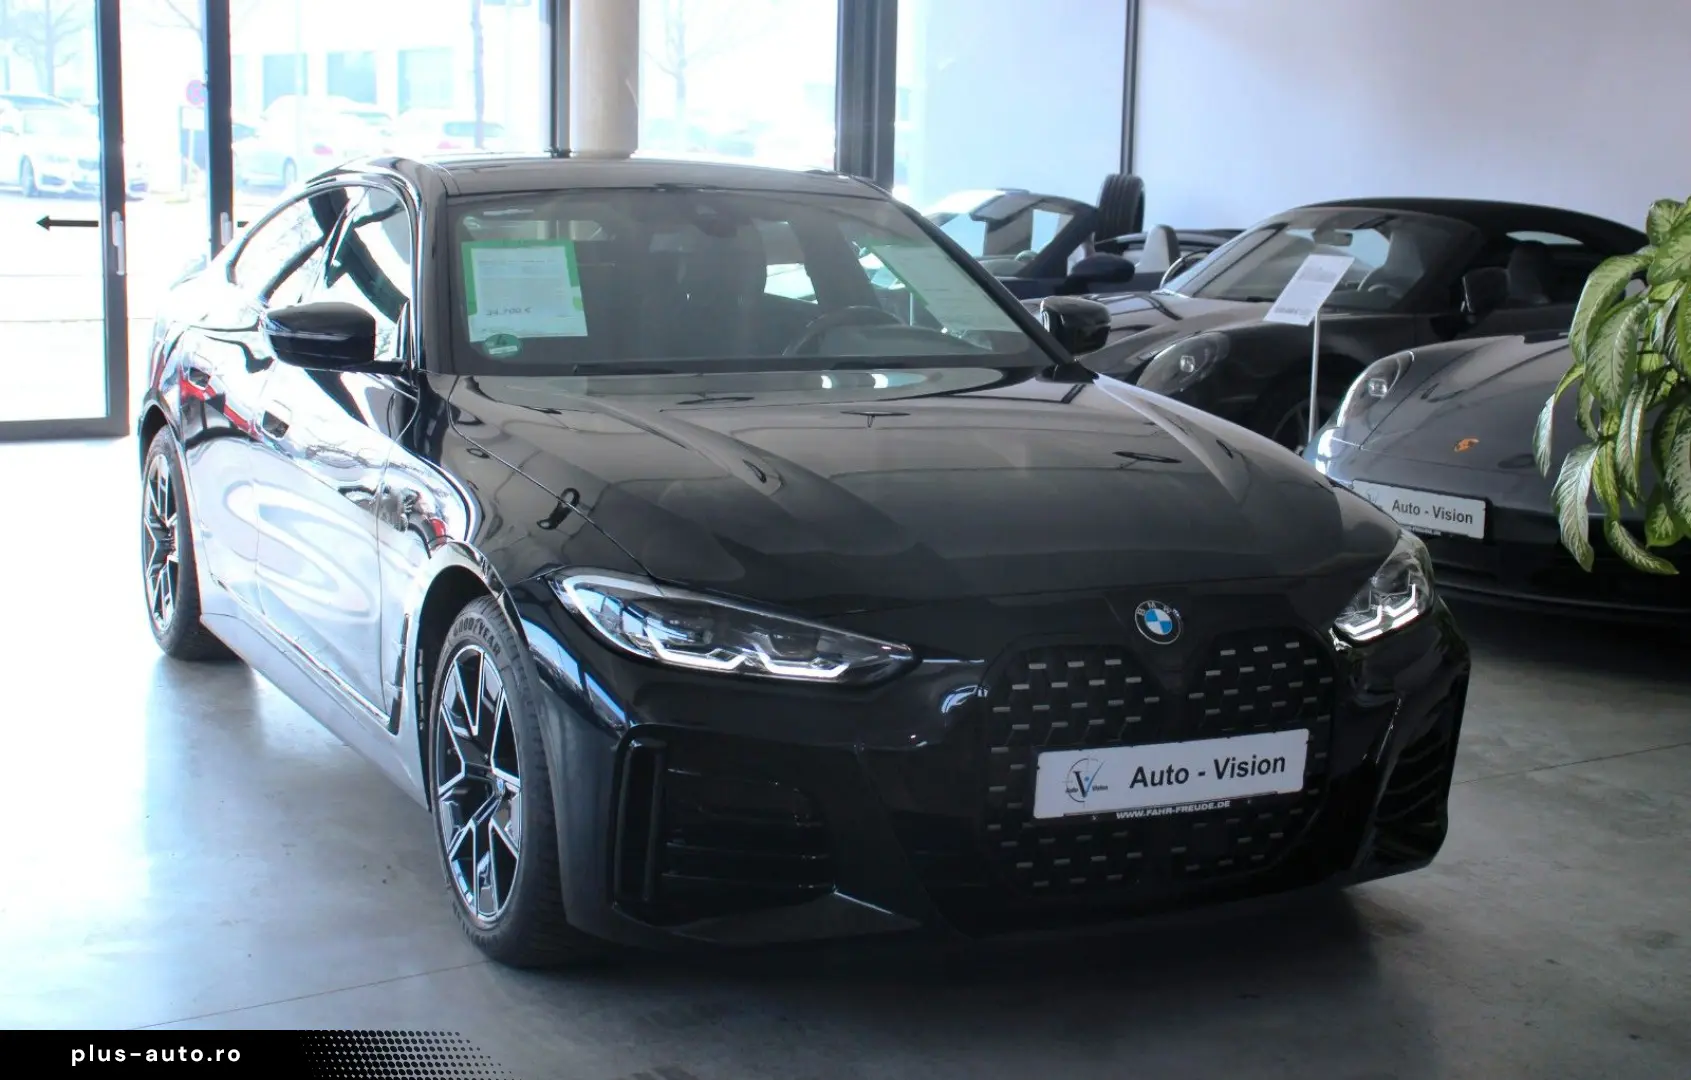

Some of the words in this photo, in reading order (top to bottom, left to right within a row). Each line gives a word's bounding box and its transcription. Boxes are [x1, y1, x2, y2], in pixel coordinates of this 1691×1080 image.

[1391, 499, 1421, 516] Auto
[1432, 505, 1473, 525] Vision
[1136, 601, 1173, 616] BMW
[453, 617, 500, 654] GOODYEAR
[1129, 763, 1189, 789] Auto
[1213, 754, 1286, 780] Vision
[1115, 800, 1231, 820] WWW.FAHR-FREUDE.DE
